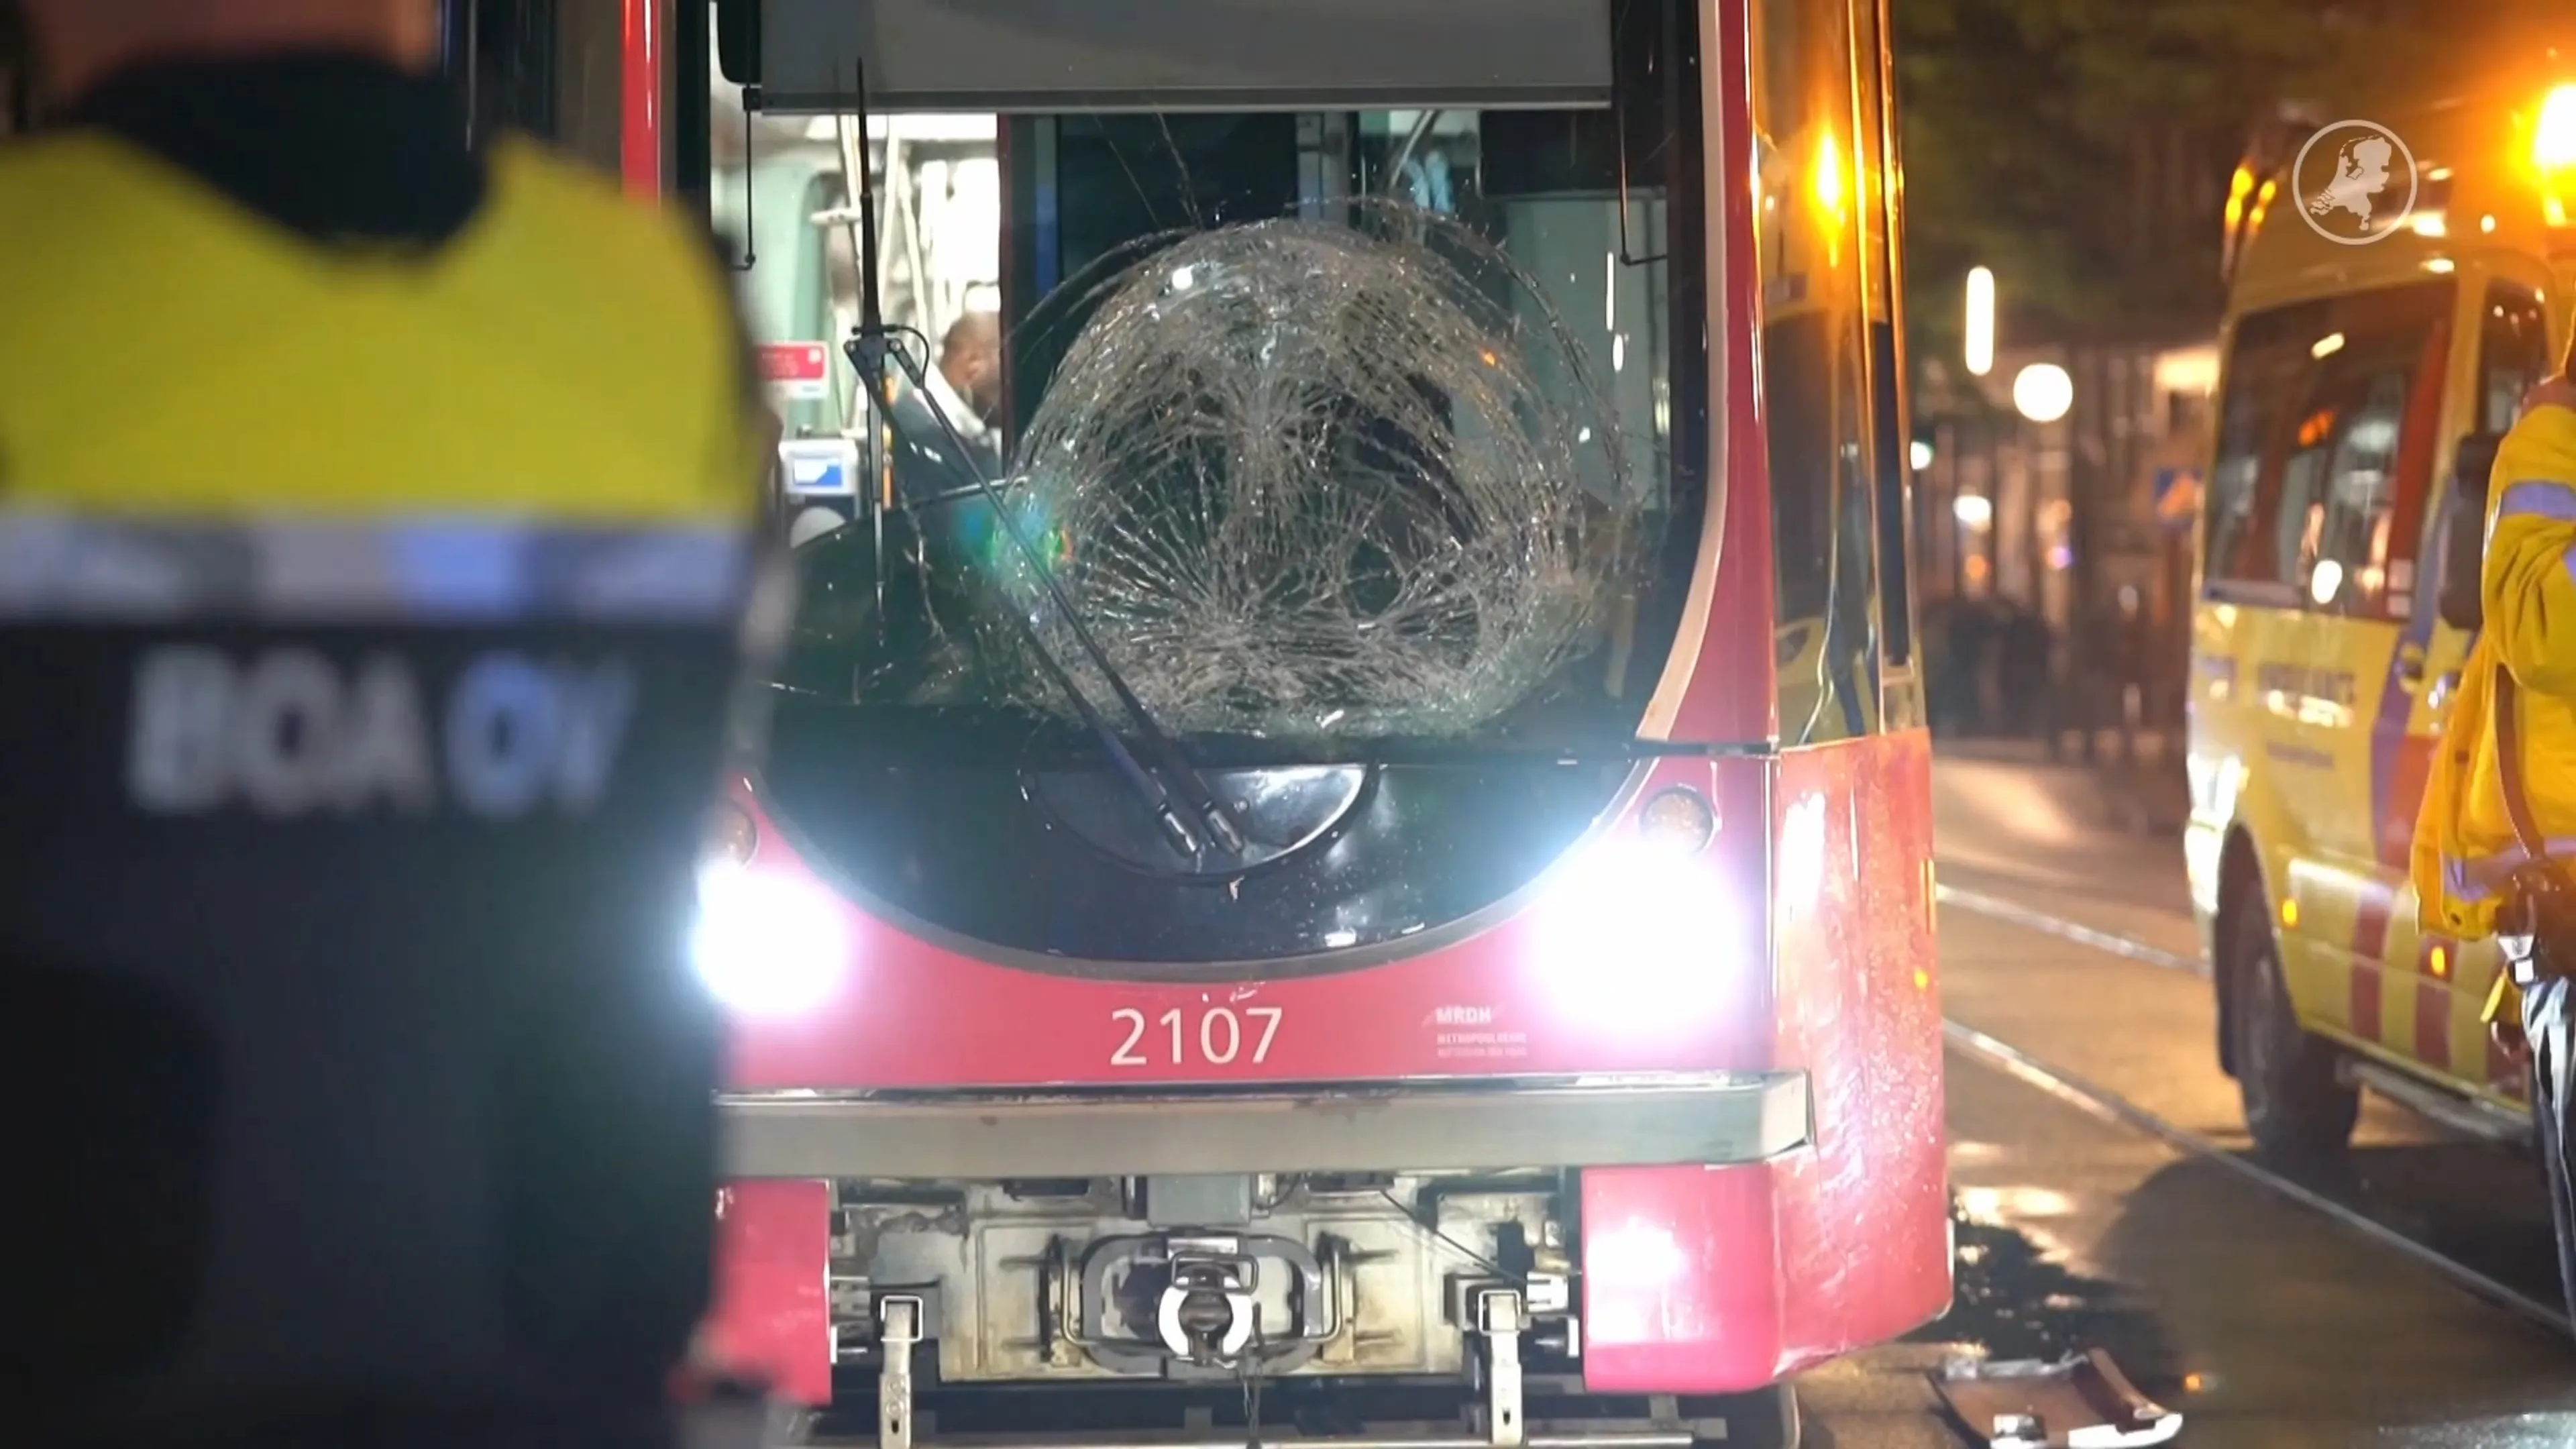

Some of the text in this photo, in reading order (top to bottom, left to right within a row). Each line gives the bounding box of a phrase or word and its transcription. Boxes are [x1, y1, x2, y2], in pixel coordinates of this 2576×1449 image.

[131, 645, 436, 813] BOA
[1111, 1007, 1283, 1065] 2107
[1436, 1006, 1493, 1024] MRDH
